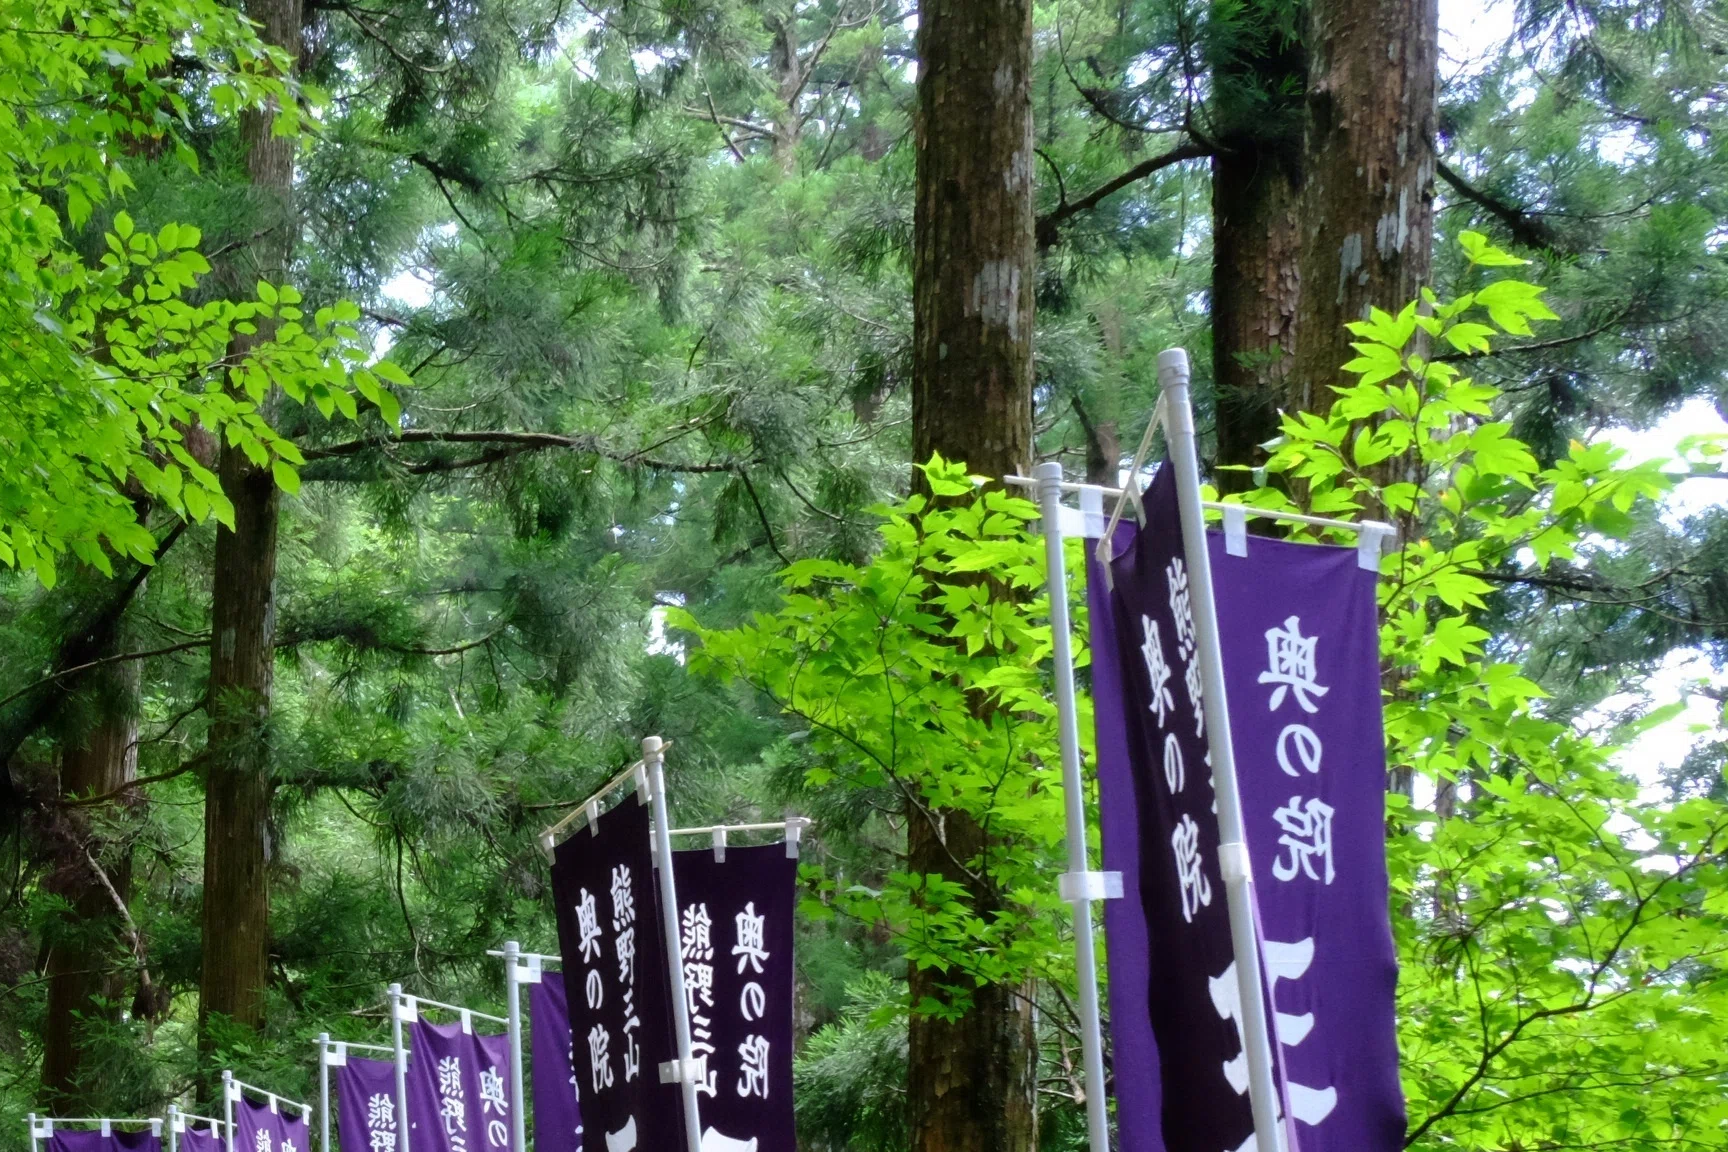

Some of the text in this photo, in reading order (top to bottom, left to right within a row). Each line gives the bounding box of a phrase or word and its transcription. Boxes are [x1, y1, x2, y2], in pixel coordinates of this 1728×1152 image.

[1139, 614, 1212, 924] 奥の院
[575, 888, 614, 1095] 奥の院
[610, 864, 641, 1084] 熊野三山
